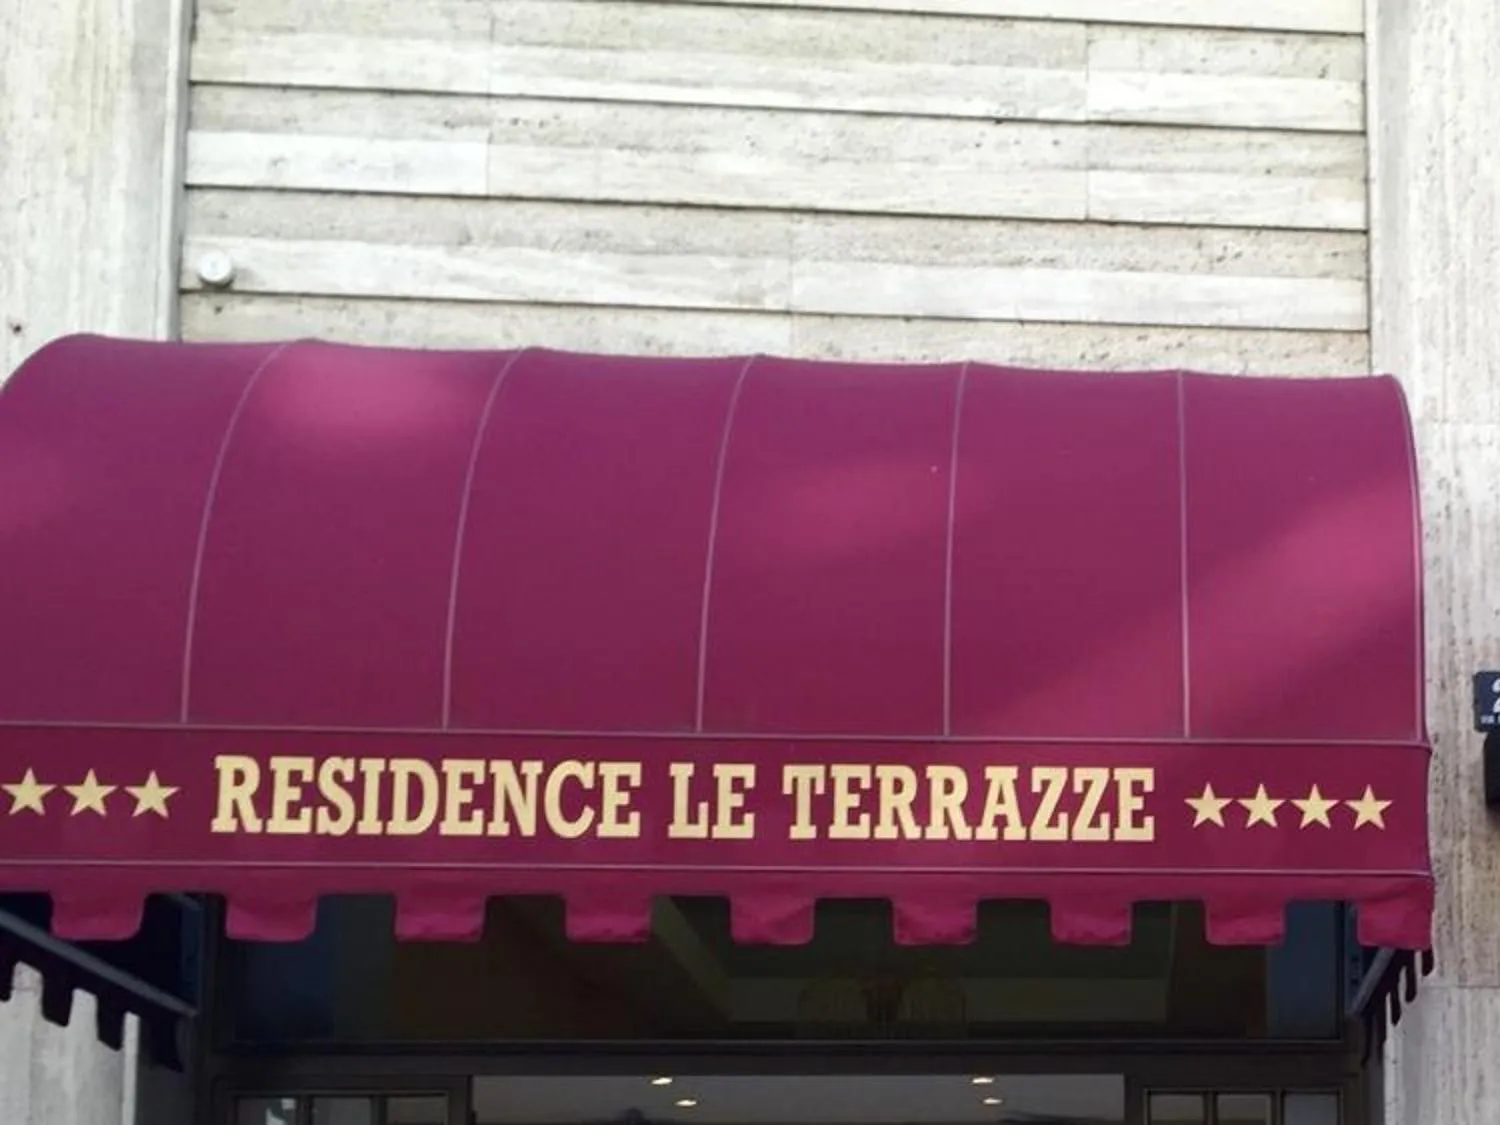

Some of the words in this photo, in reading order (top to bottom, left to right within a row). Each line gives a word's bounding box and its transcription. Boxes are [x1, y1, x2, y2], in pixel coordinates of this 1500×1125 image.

[211, 754, 641, 839] RESIDENCE
[668, 761, 757, 840] LE
[782, 763, 1156, 843] TERRAZZE
